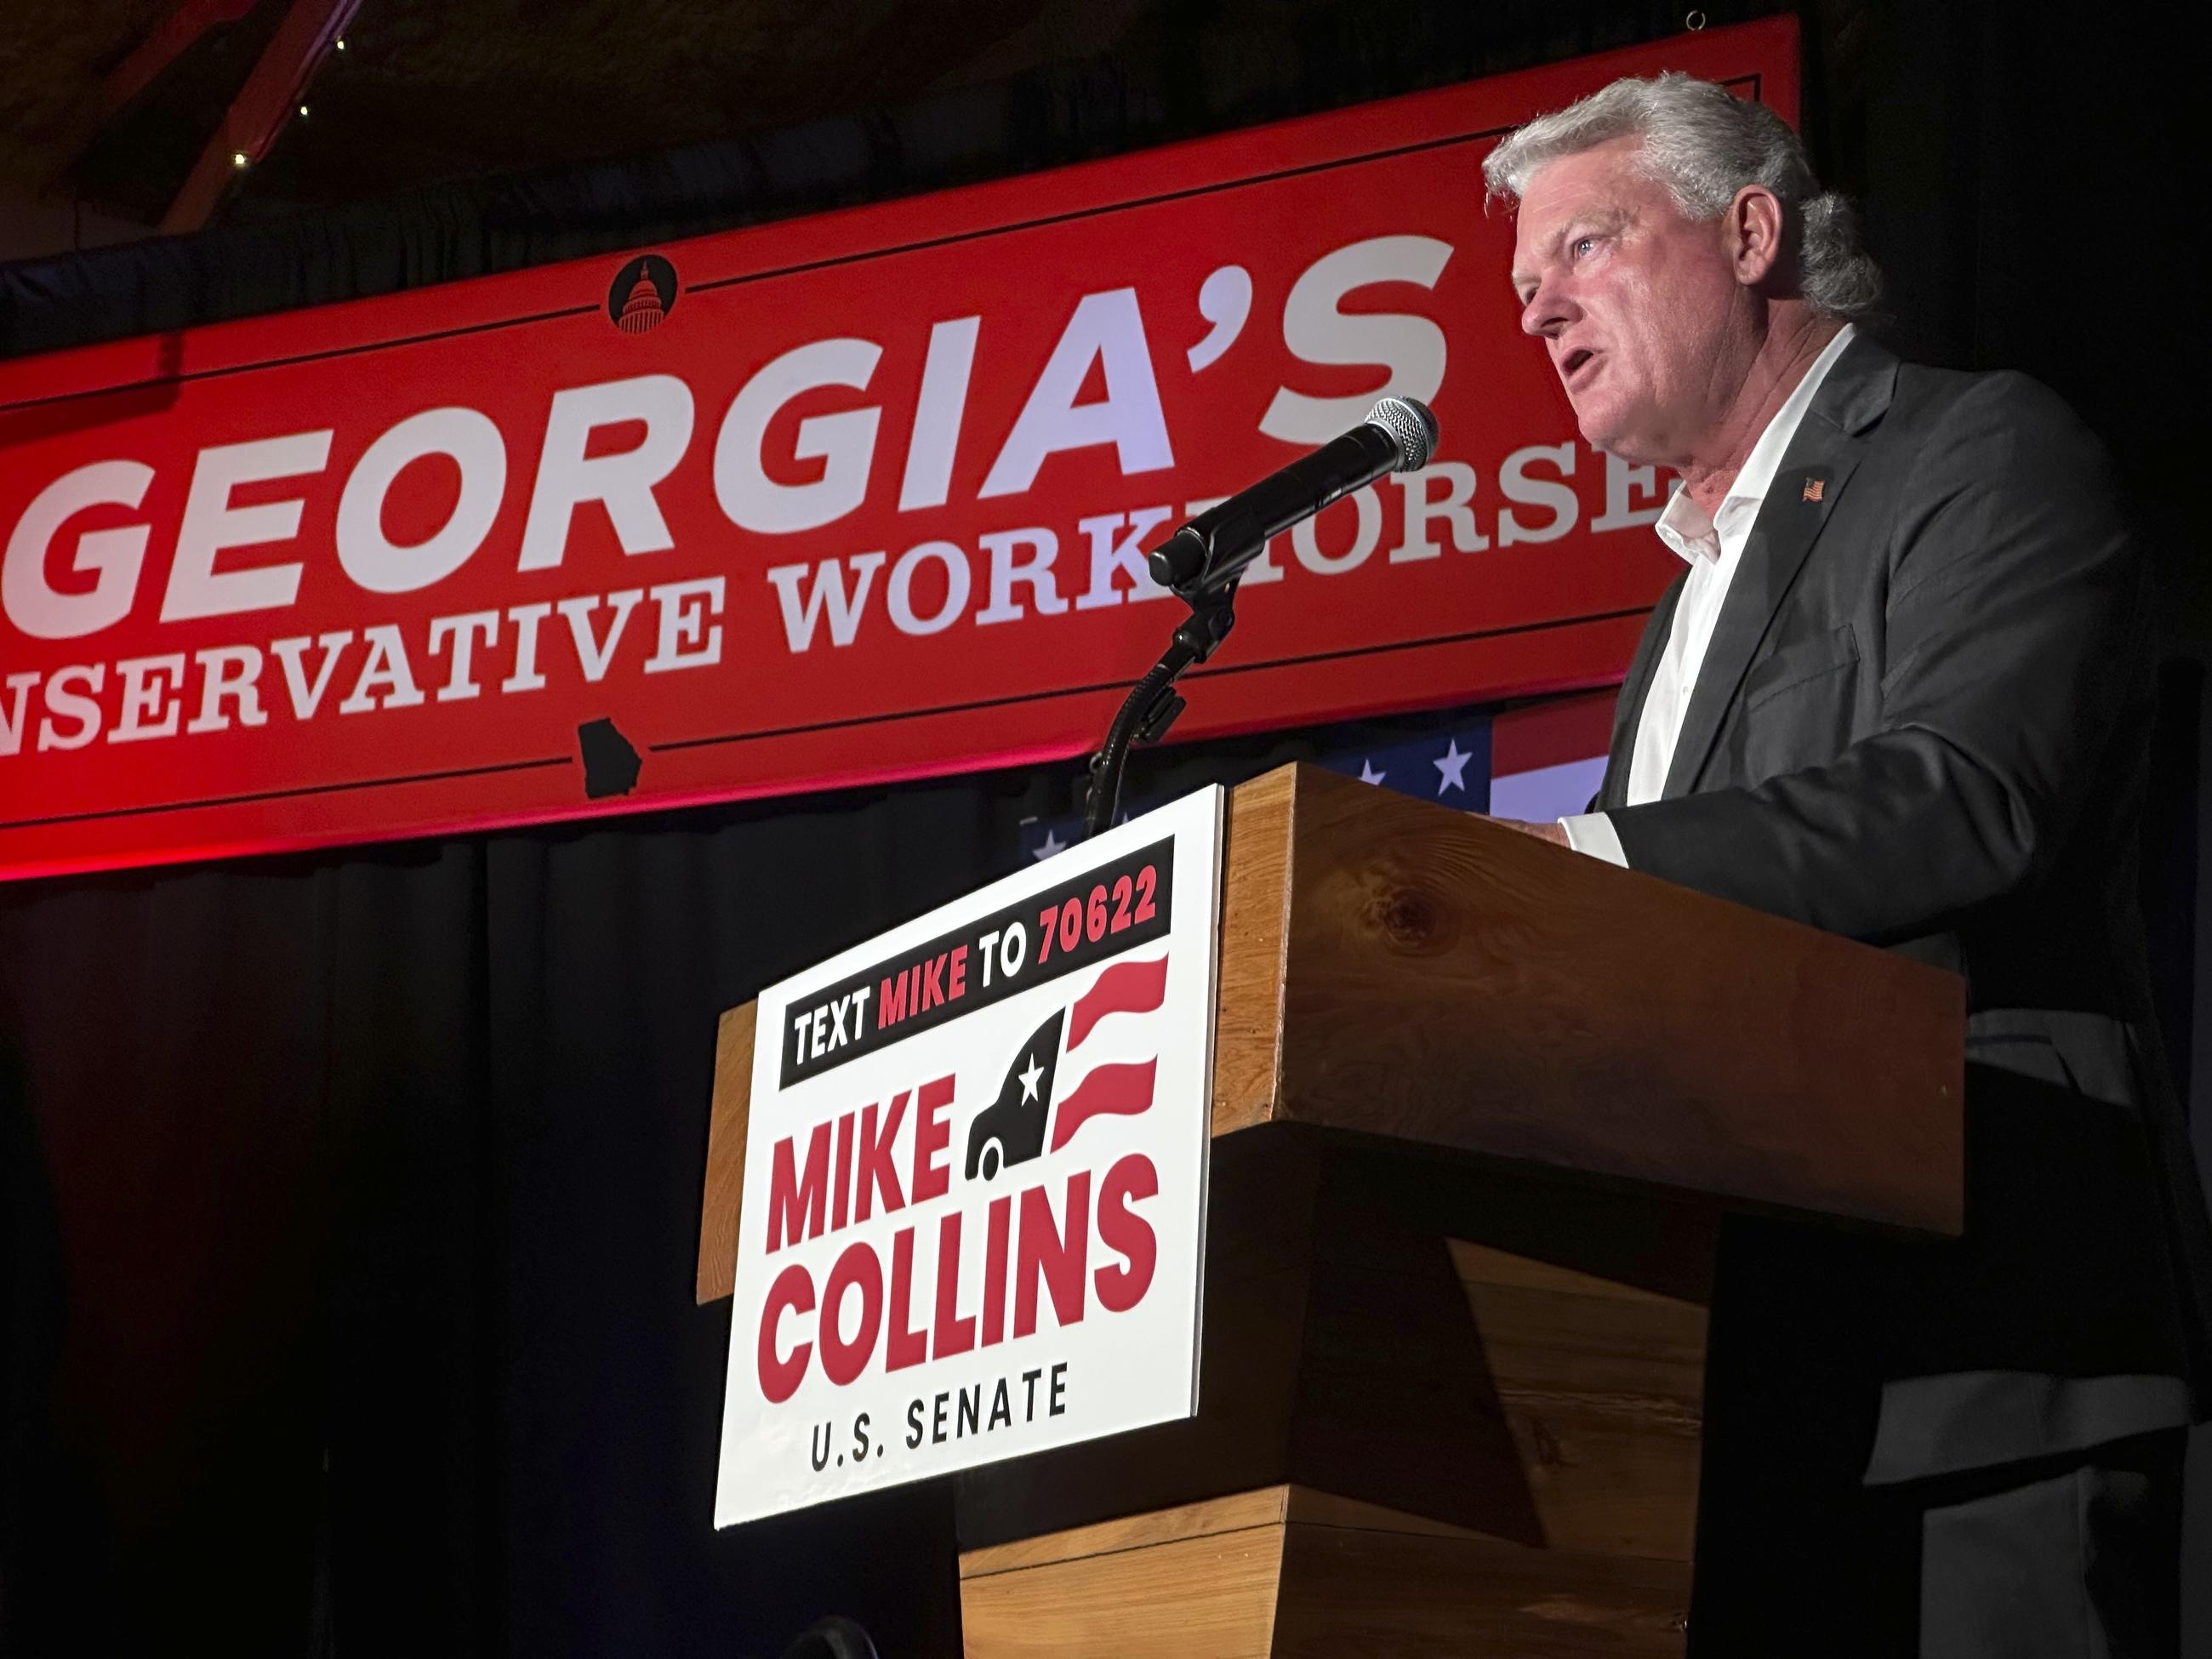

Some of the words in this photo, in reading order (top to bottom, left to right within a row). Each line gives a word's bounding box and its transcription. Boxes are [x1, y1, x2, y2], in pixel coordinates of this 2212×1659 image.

[2, 235, 1454, 639] GEORGIA'S
[767, 442, 1687, 653] WORKORSE
[793, 985, 872, 1067] TEXT
[877, 944, 969, 1029] MIKE
[978, 921, 1028, 989] TO
[1038, 864, 1157, 965] 70622
[766, 1073, 956, 1254] MIKE
[757, 1153, 1159, 1404] COLLINS
[811, 1412, 885, 1473] U.S.
[905, 1361, 1069, 1451] SENATE
